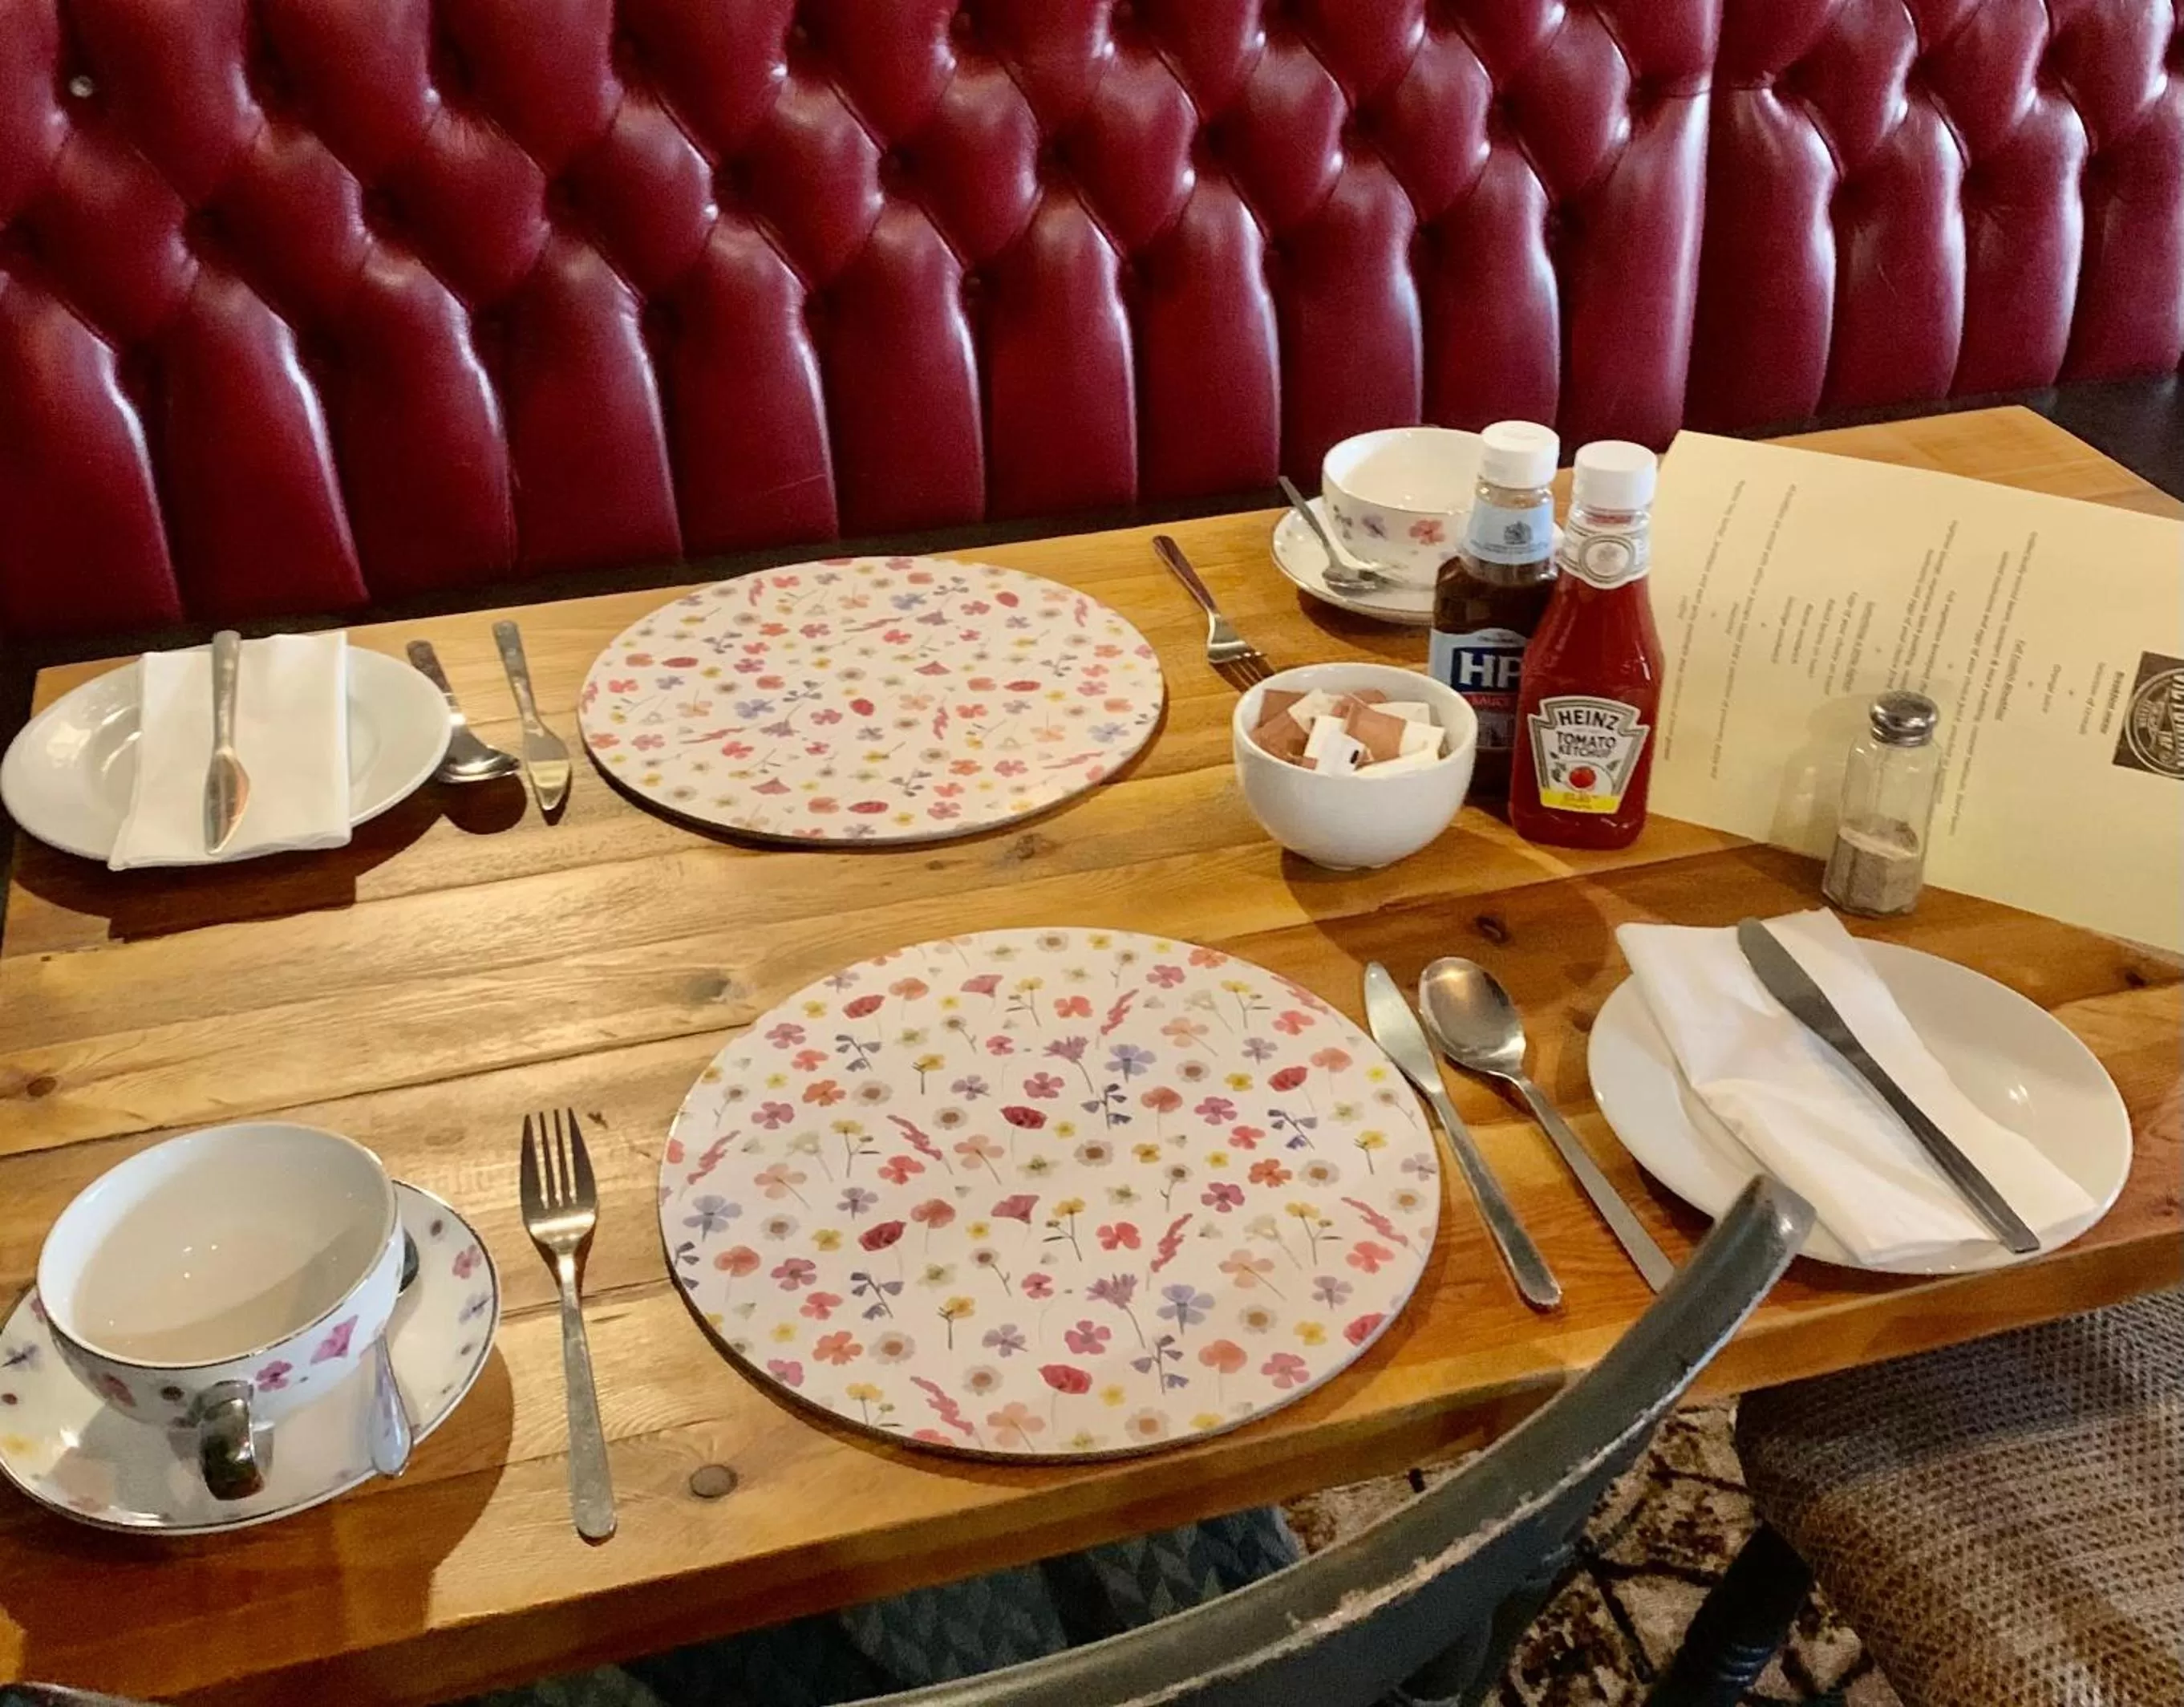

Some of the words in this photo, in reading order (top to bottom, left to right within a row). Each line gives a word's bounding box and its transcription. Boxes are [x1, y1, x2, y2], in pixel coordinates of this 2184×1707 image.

[1459, 651, 1522, 688] HP
[1558, 710, 1619, 731] HEINZ
[1556, 731, 1617, 749] TOMATO
